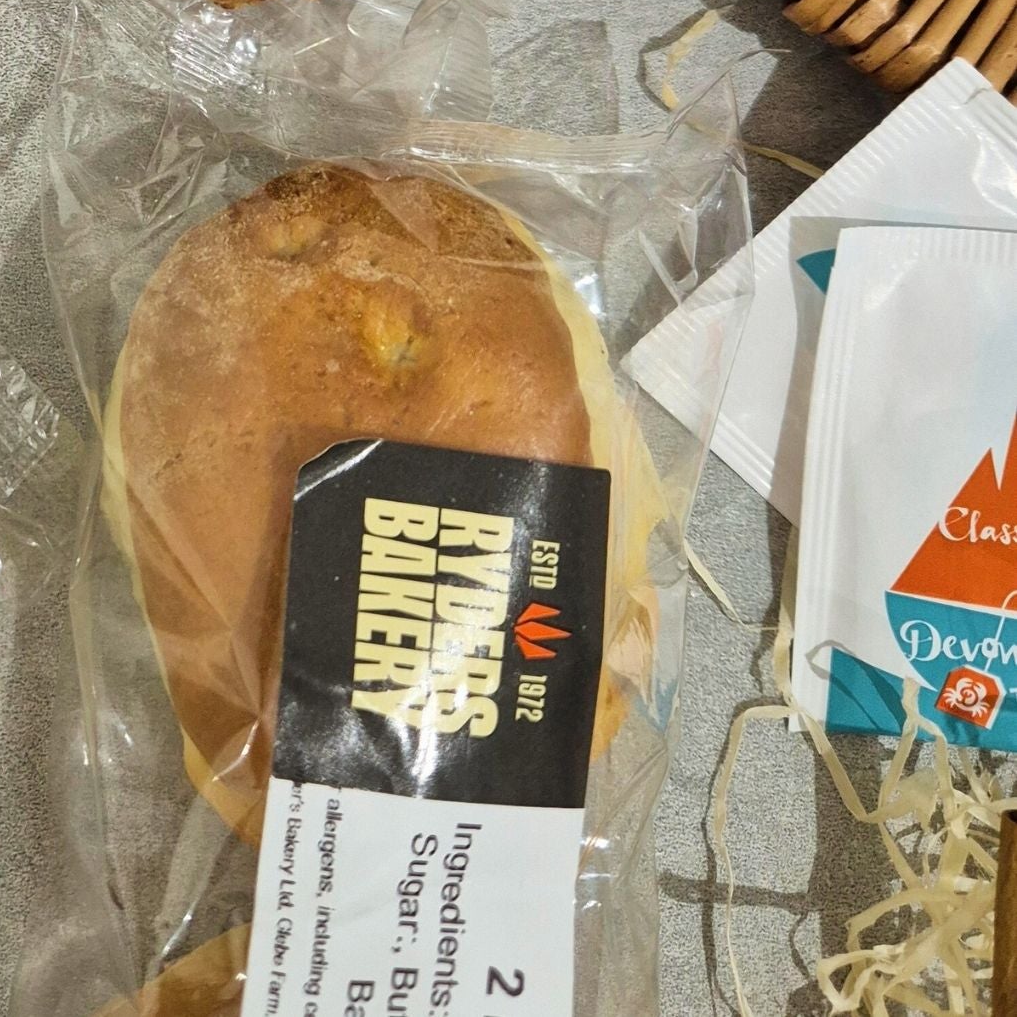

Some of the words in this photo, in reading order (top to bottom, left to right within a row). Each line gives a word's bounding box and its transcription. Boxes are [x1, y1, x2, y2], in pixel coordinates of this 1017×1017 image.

[528, 538, 561, 591] ESTD
[350, 496, 441, 733] BAKERY
[432, 508, 515, 739] RYDERS
[514, 673, 548, 723] 1972
[278, 817, 303, 876] Bakery
[316, 798, 344, 897] allergens,
[302, 905, 336, 996] including
[430, 822, 483, 1017] Ingredients:
[486, 965, 526, 998] 2
